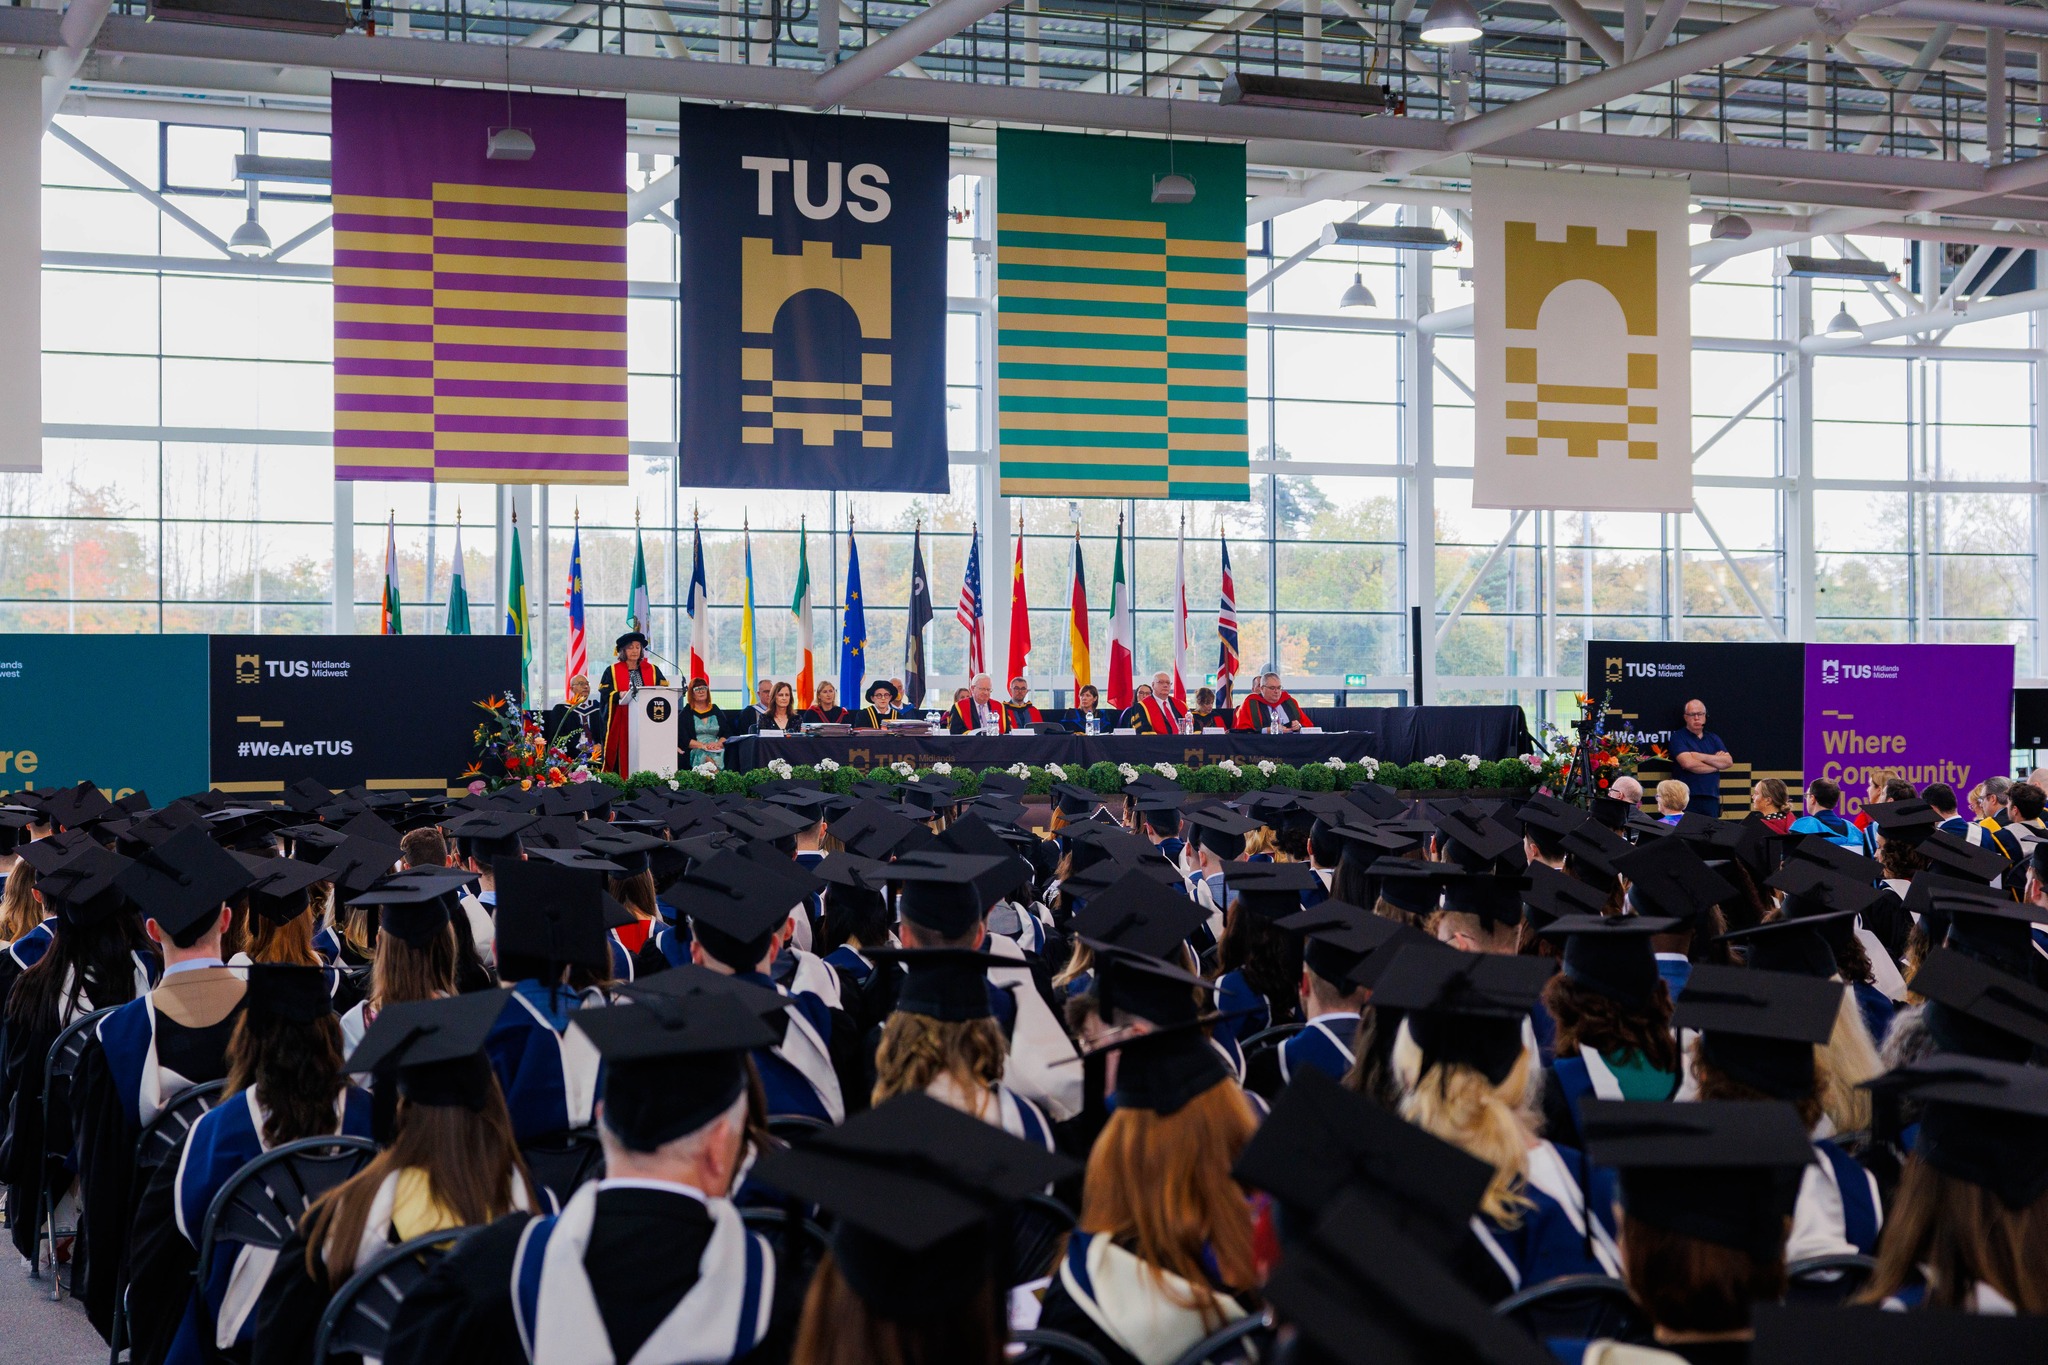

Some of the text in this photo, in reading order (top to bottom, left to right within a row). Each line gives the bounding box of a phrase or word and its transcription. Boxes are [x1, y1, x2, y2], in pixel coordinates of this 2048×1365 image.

[741, 155, 892, 223] TUS
[0, 660, 23, 669] ands
[265, 660, 309, 678] TUS
[311, 660, 351, 669] Midlands
[1626, 663, 1657, 677] TUS
[1842, 664, 1872, 679] TUS
[1873, 664, 1900, 672] Midlands
[311, 669, 348, 677] Midwest
[1873, 671, 1898, 679] Midwest
[1607, 730, 1672, 744] WeAreT
[1822, 729, 1907, 754] Where
[238, 740, 353, 757] #WeAreTUS
[1822, 758, 1971, 789] Community
